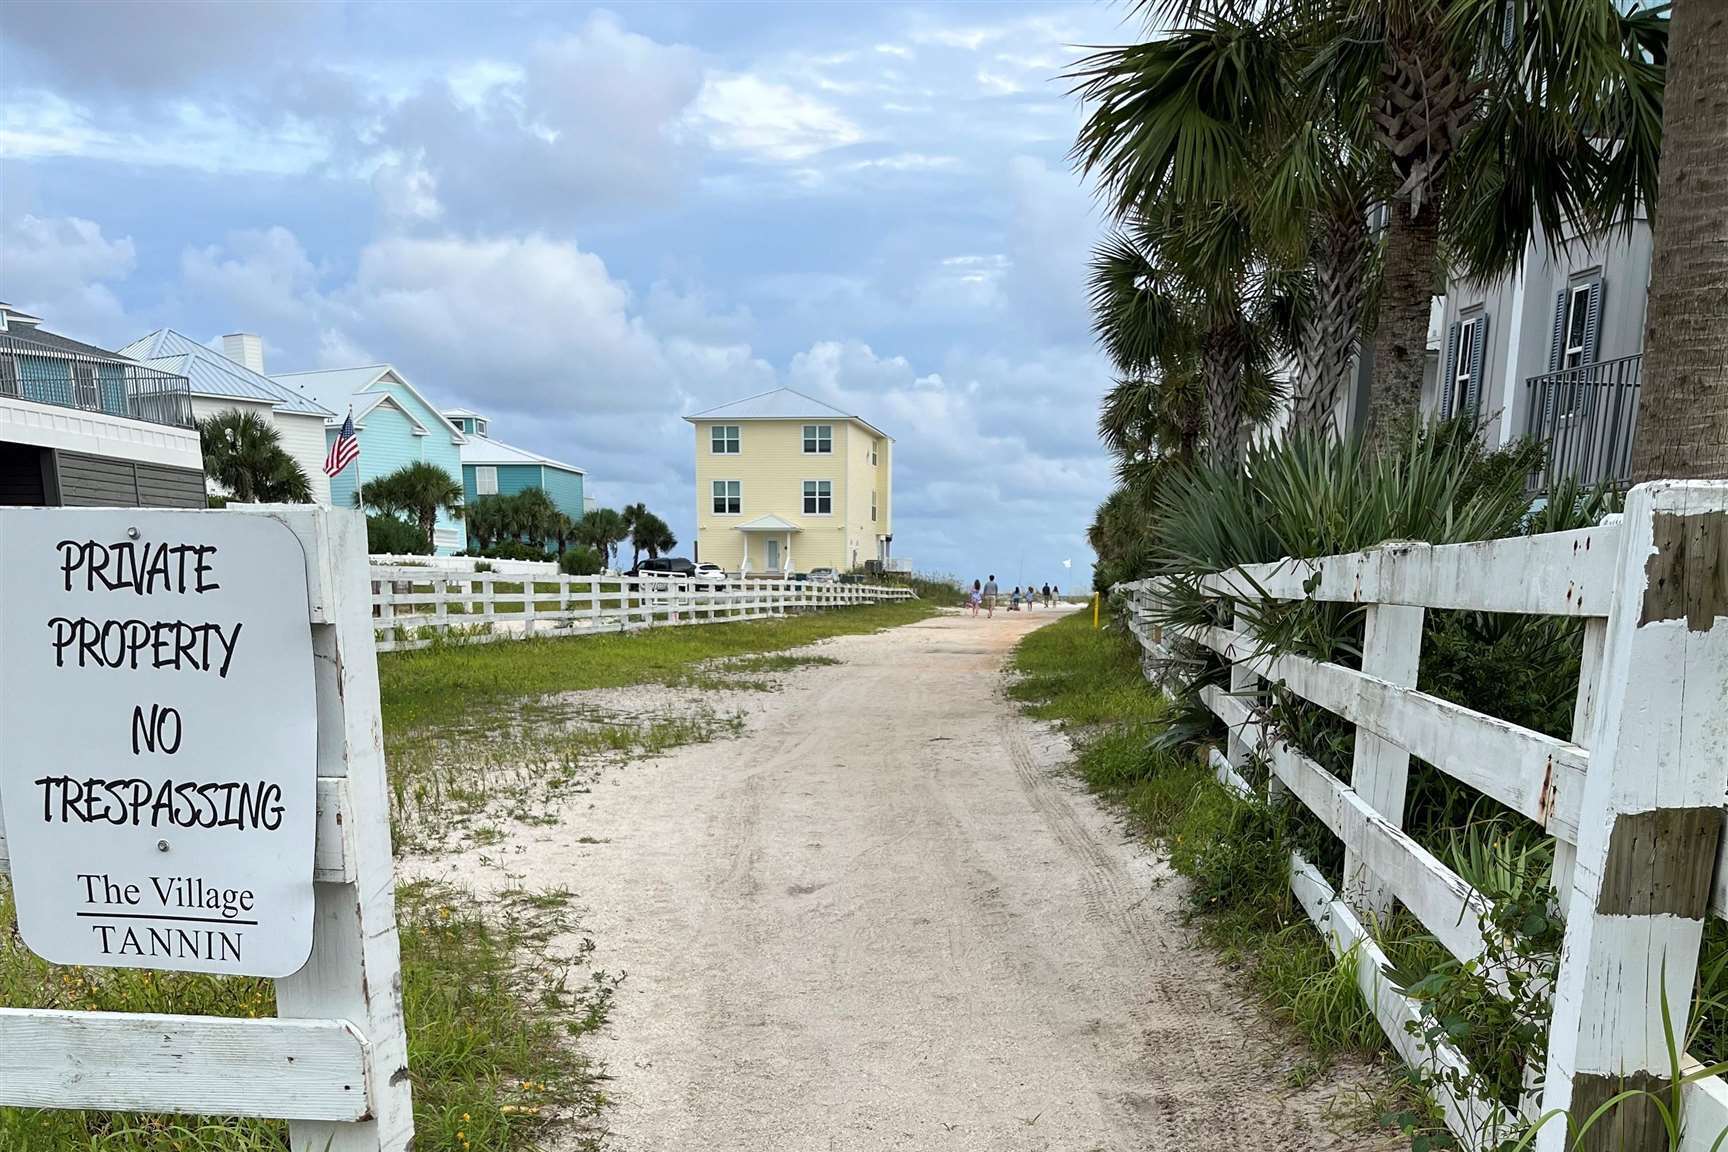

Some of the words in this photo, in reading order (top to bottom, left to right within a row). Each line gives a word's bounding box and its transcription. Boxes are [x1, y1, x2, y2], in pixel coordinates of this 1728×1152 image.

[56, 540, 221, 596] PRIVATE
[48, 617, 243, 679] PROPERTY
[132, 703, 182, 755] NO
[35, 775, 286, 831] TRESPASSING
[77, 874, 141, 905] The
[150, 876, 255, 919] Village
[92, 925, 243, 962] TANNIN
